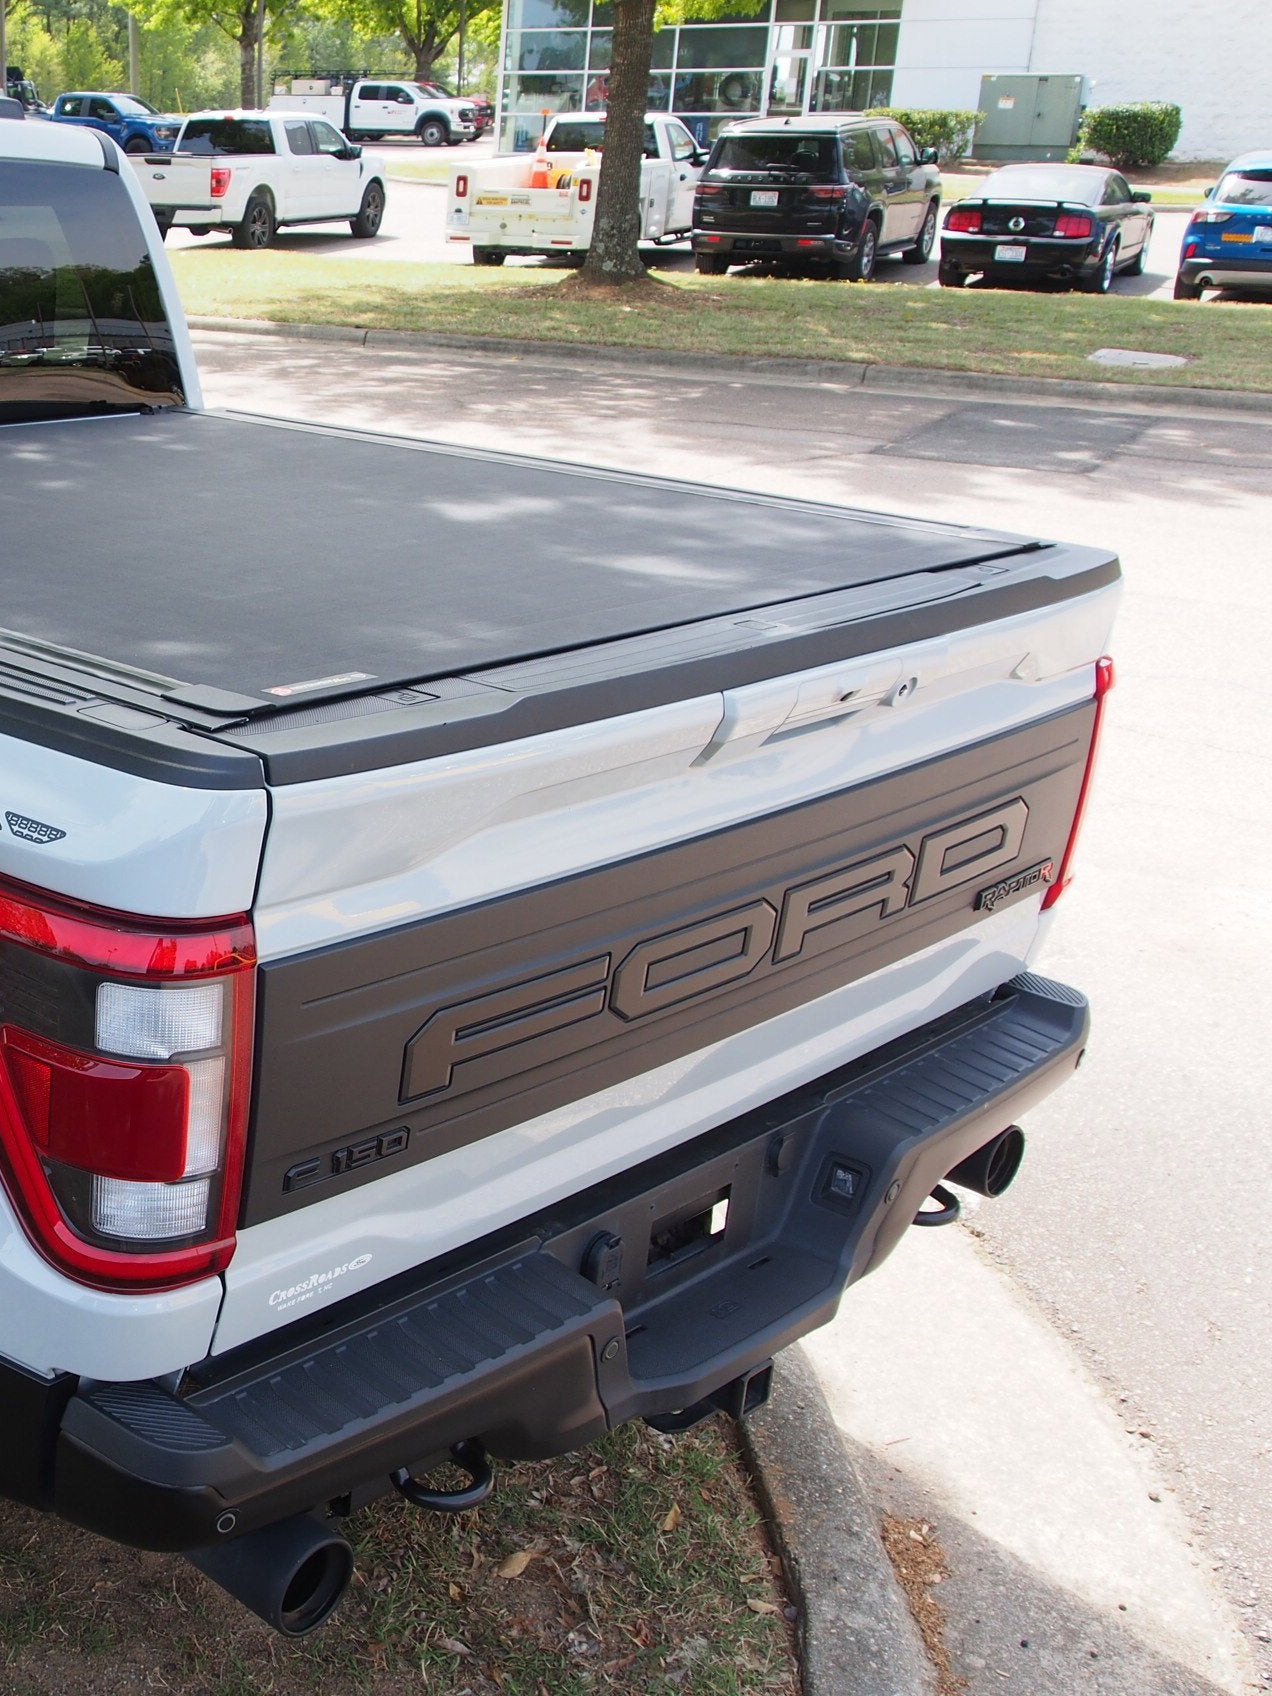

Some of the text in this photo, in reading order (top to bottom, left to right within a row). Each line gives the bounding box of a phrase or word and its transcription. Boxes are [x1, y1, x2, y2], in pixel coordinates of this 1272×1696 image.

[974, 860, 1054, 911] RAPTOR
[397, 795, 1030, 1107] FORD
[268, 1263, 349, 1306] CROSSROADS
